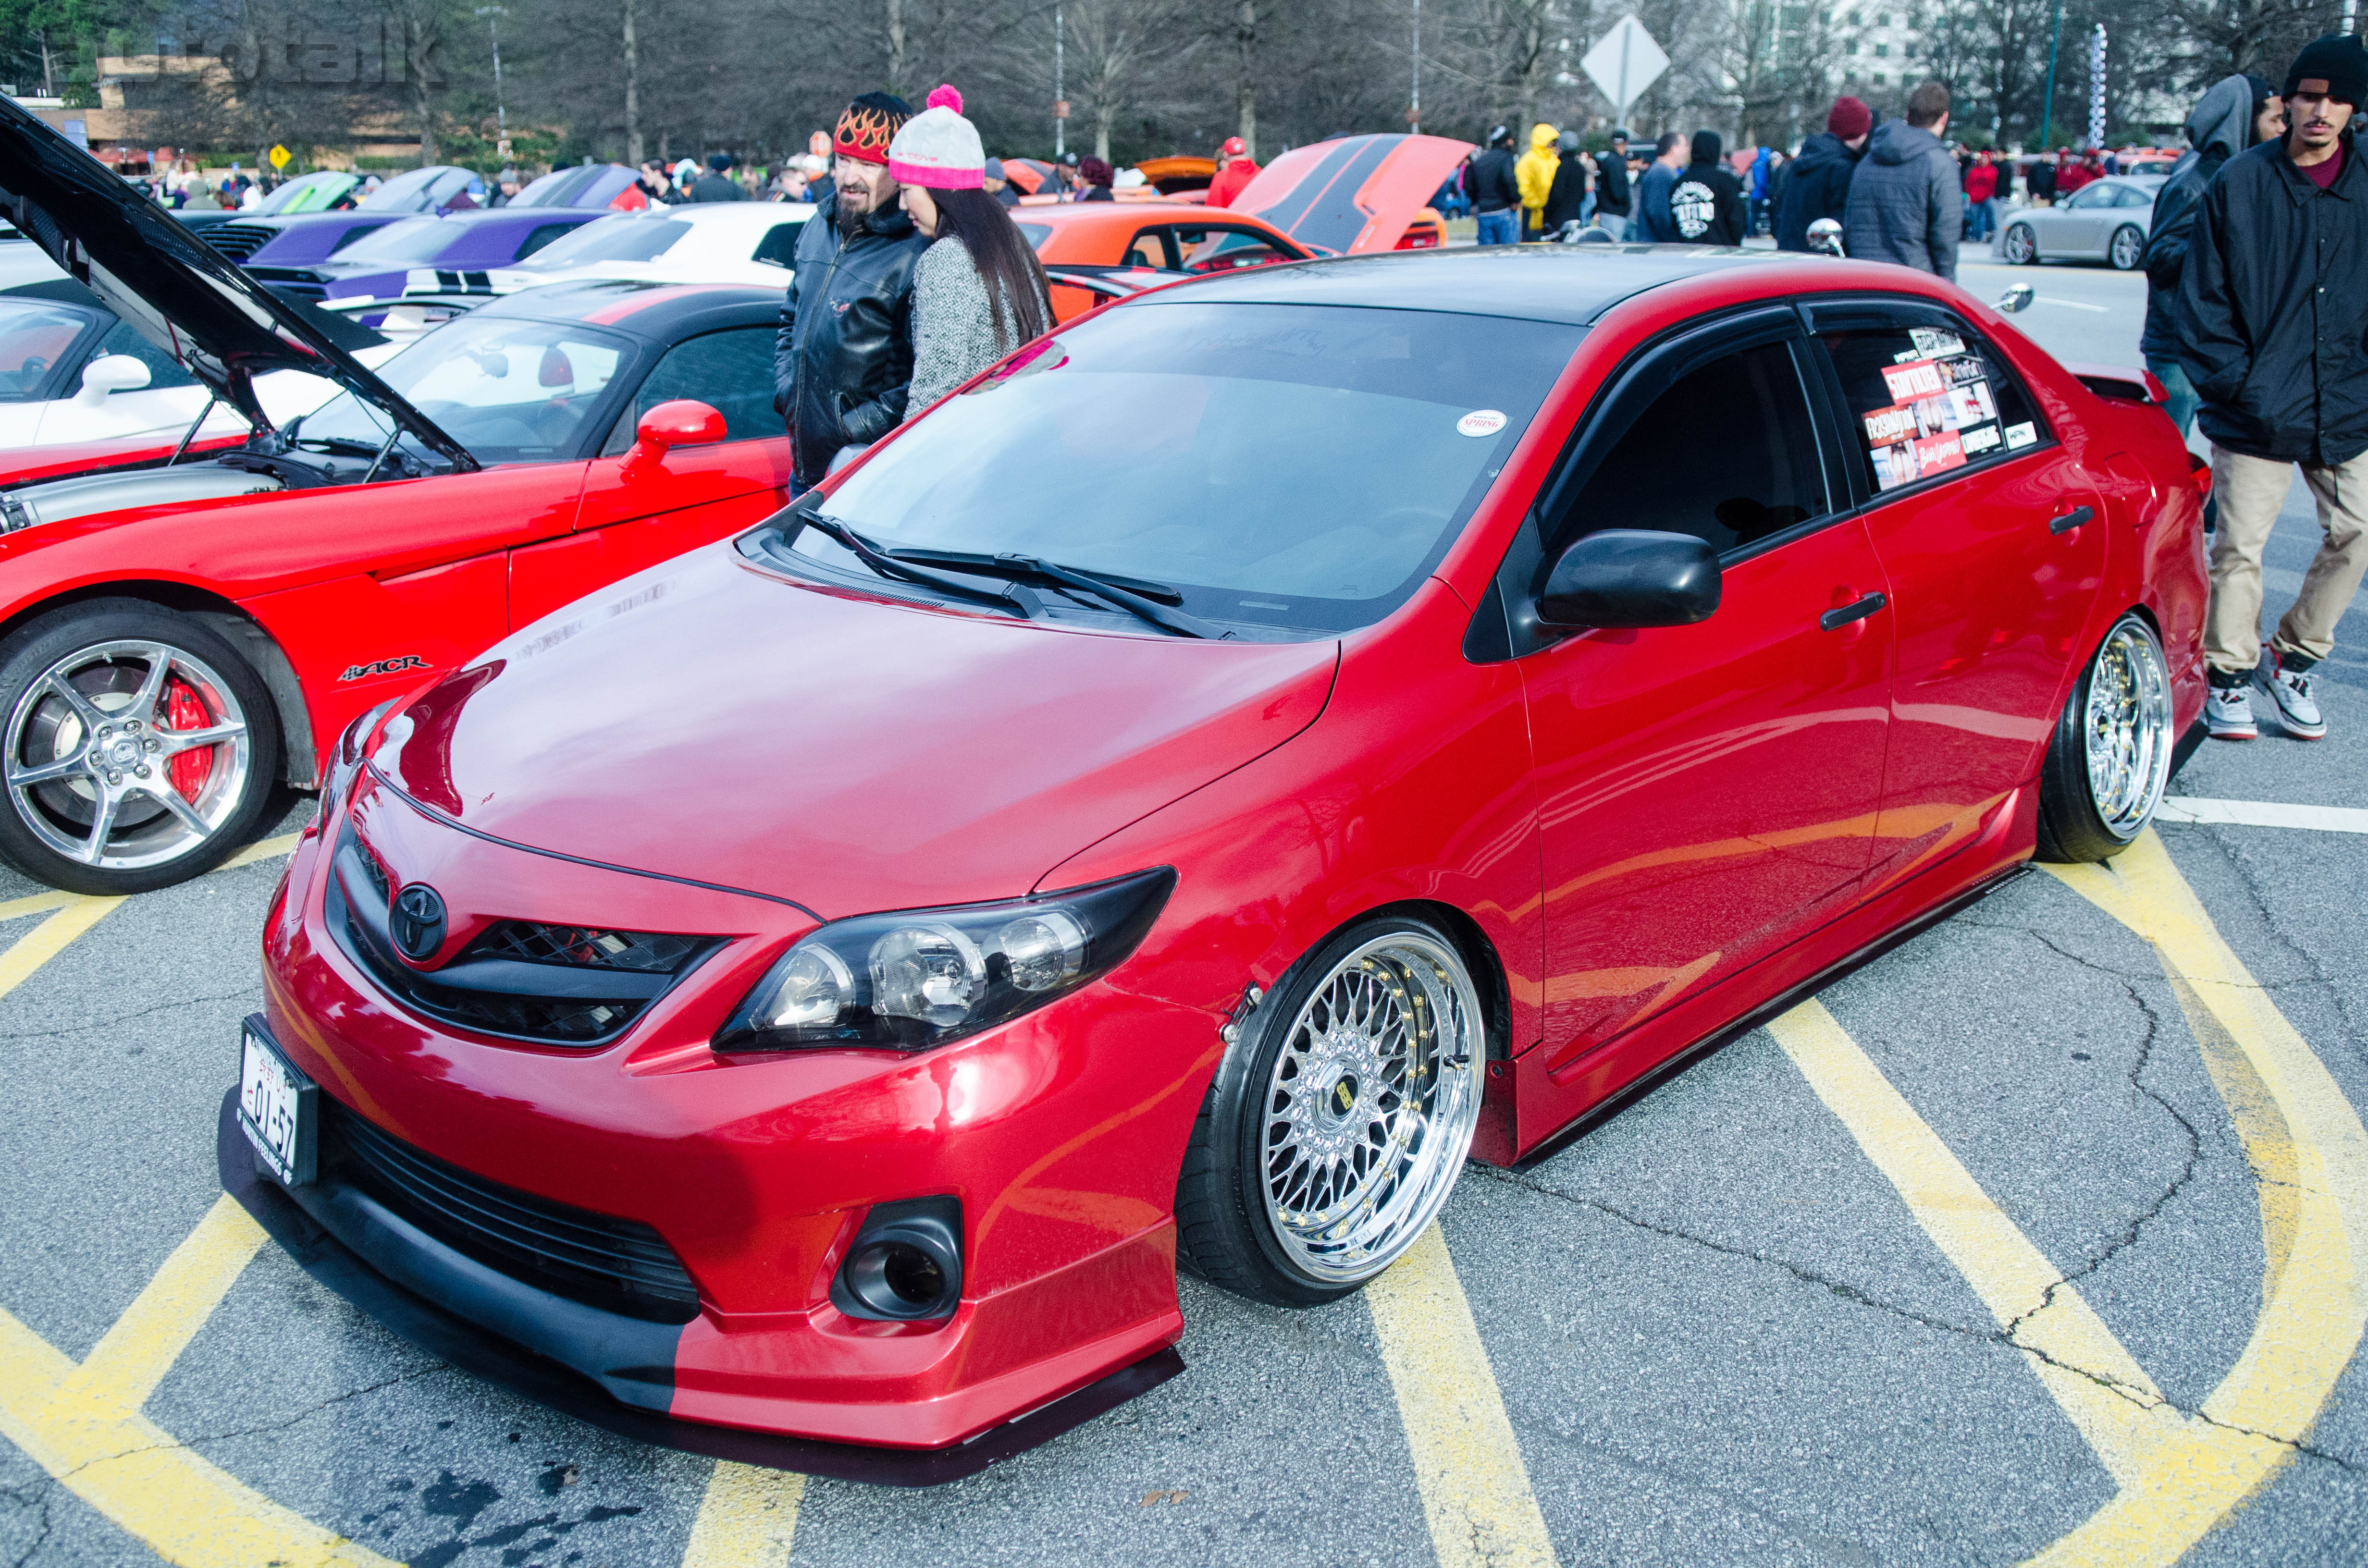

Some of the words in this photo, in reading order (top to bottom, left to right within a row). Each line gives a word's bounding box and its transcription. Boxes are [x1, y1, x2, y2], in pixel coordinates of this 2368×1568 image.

[1464, 418, 1499, 428] SPRING
[355, 655, 434, 677] ACR
[259, 1140, 282, 1176] FEELINGS
